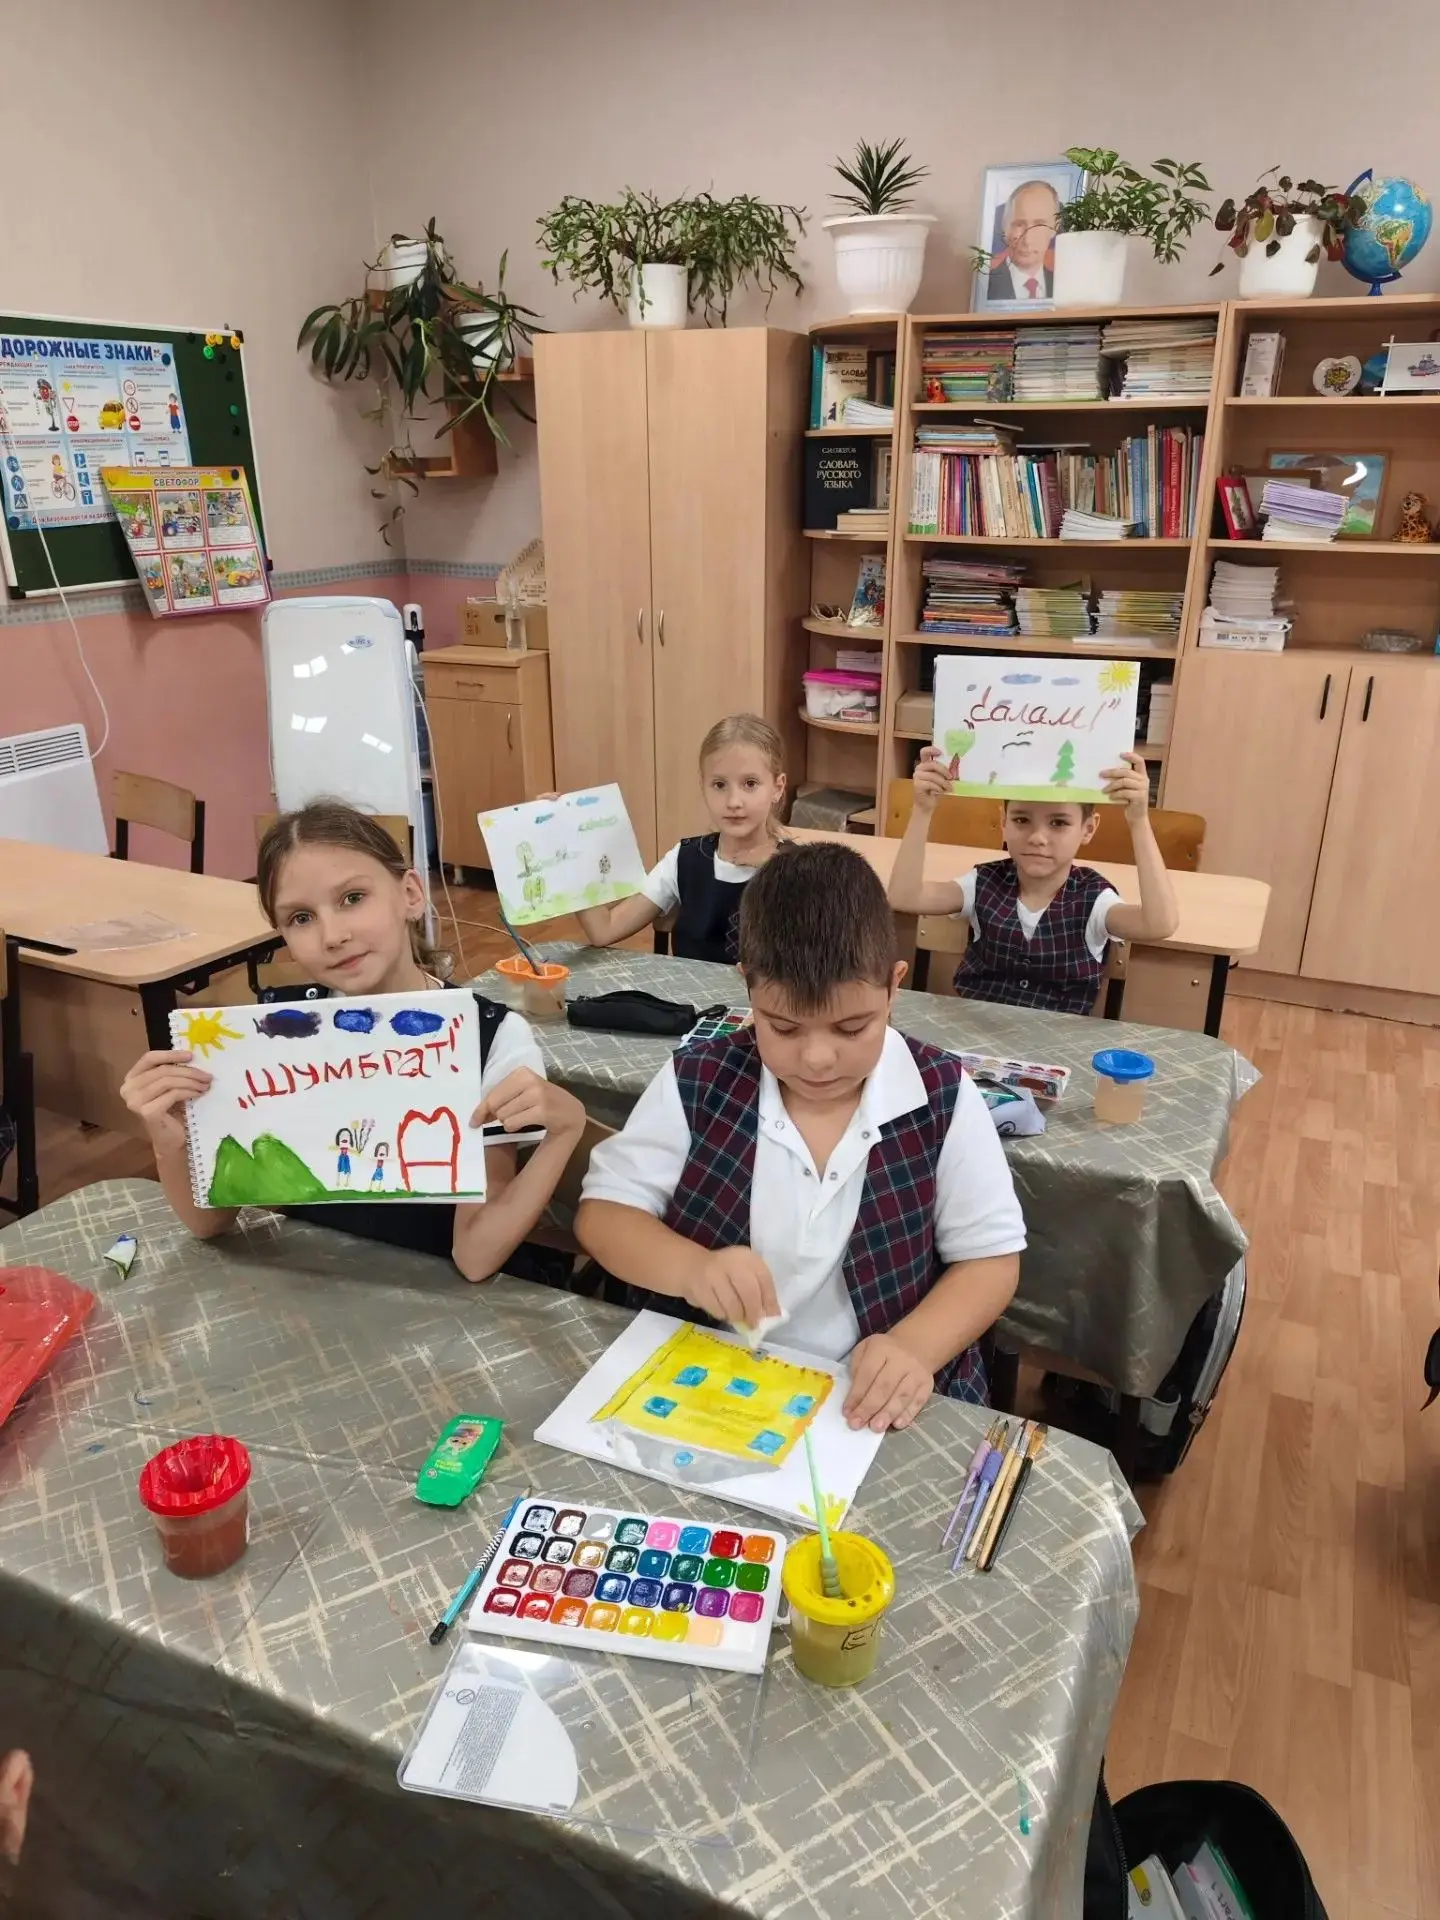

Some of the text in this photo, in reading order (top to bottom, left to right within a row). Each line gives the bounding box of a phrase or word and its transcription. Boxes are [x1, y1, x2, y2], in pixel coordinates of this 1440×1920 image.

[1, 338, 153, 361] ДОРОЖНЫЕ ЗНАКИ
[819, 460, 859, 469] СЛОВАРЬ
[816, 470, 861, 480] РУССКОГО
[153, 478, 199, 487] СВЕТОФОР
[823, 480, 853, 488] ЯЗЫКА
